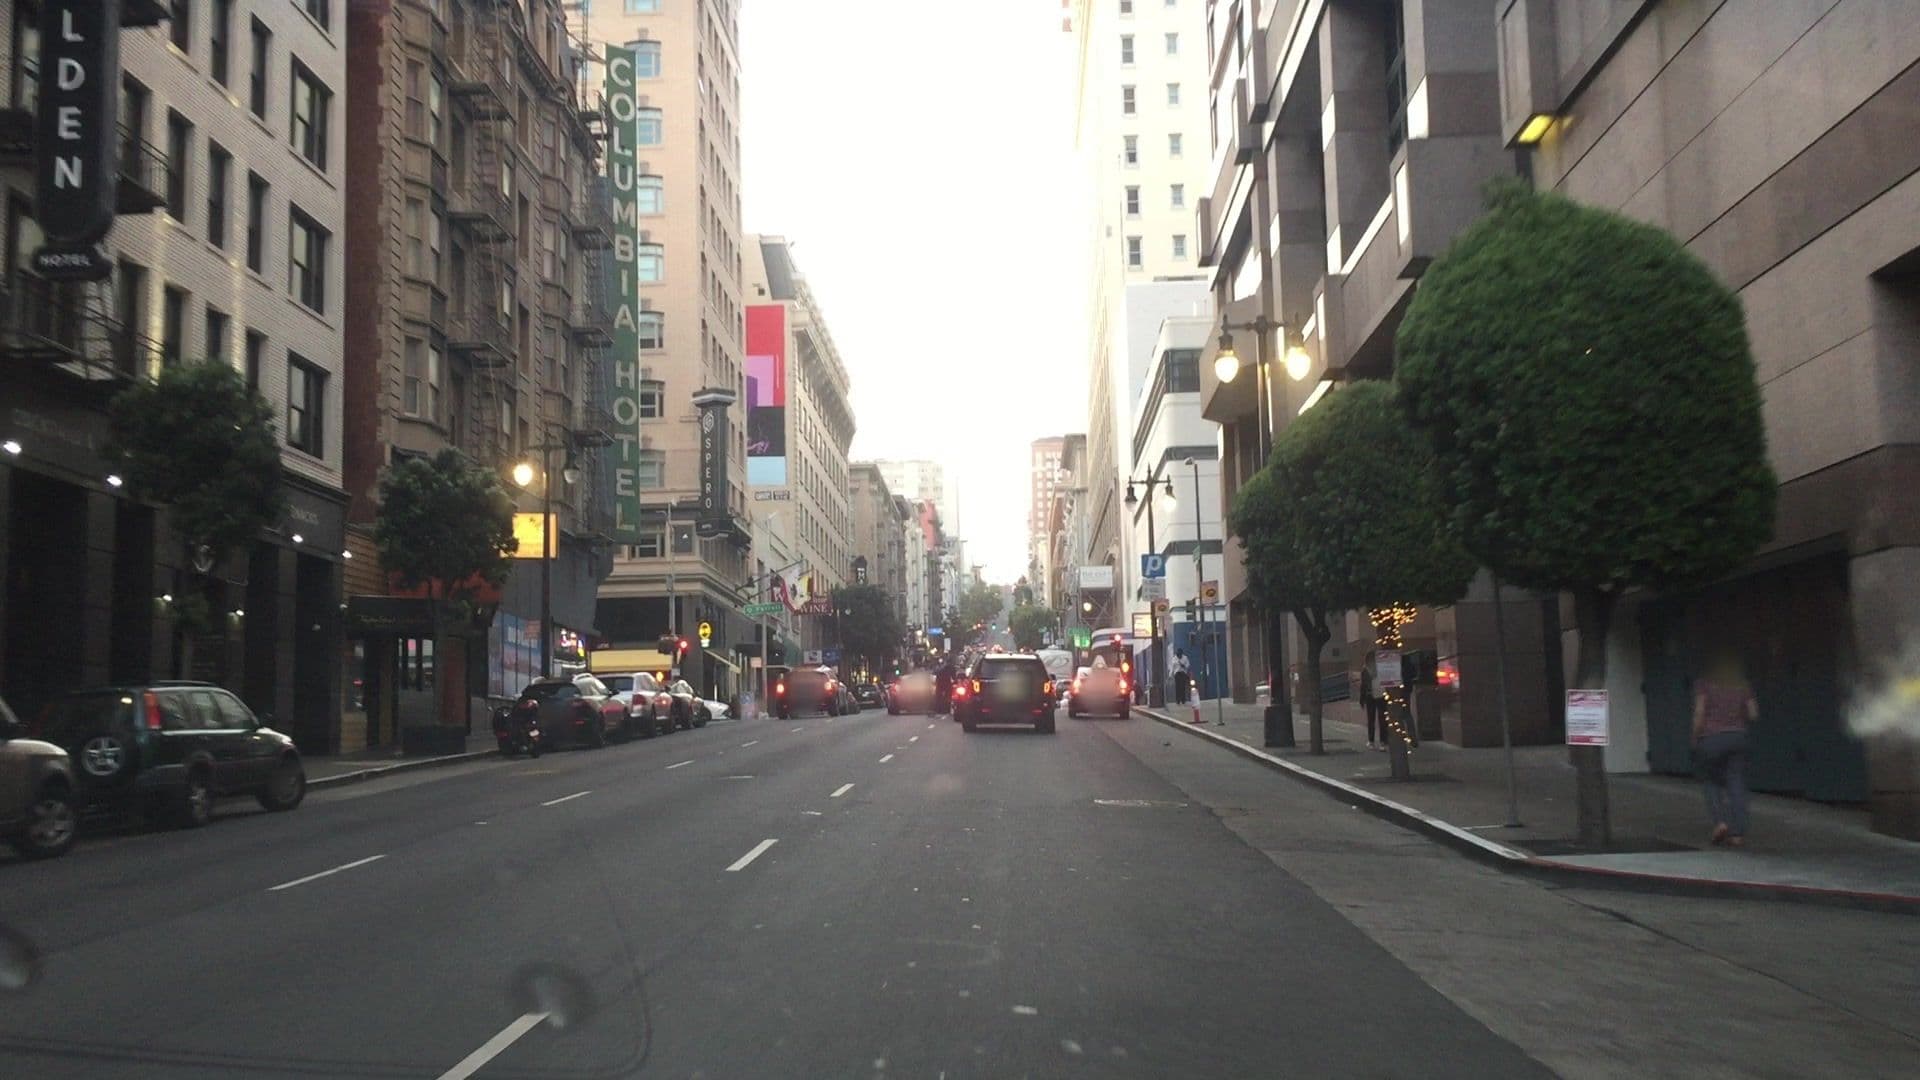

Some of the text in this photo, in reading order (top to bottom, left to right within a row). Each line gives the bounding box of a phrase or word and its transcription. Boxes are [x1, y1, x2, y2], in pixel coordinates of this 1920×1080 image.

[609, 56, 638, 531] COLUMBIA HOTEL
[704, 437, 713, 509] SPERO
[1145, 555, 1163, 576] P
